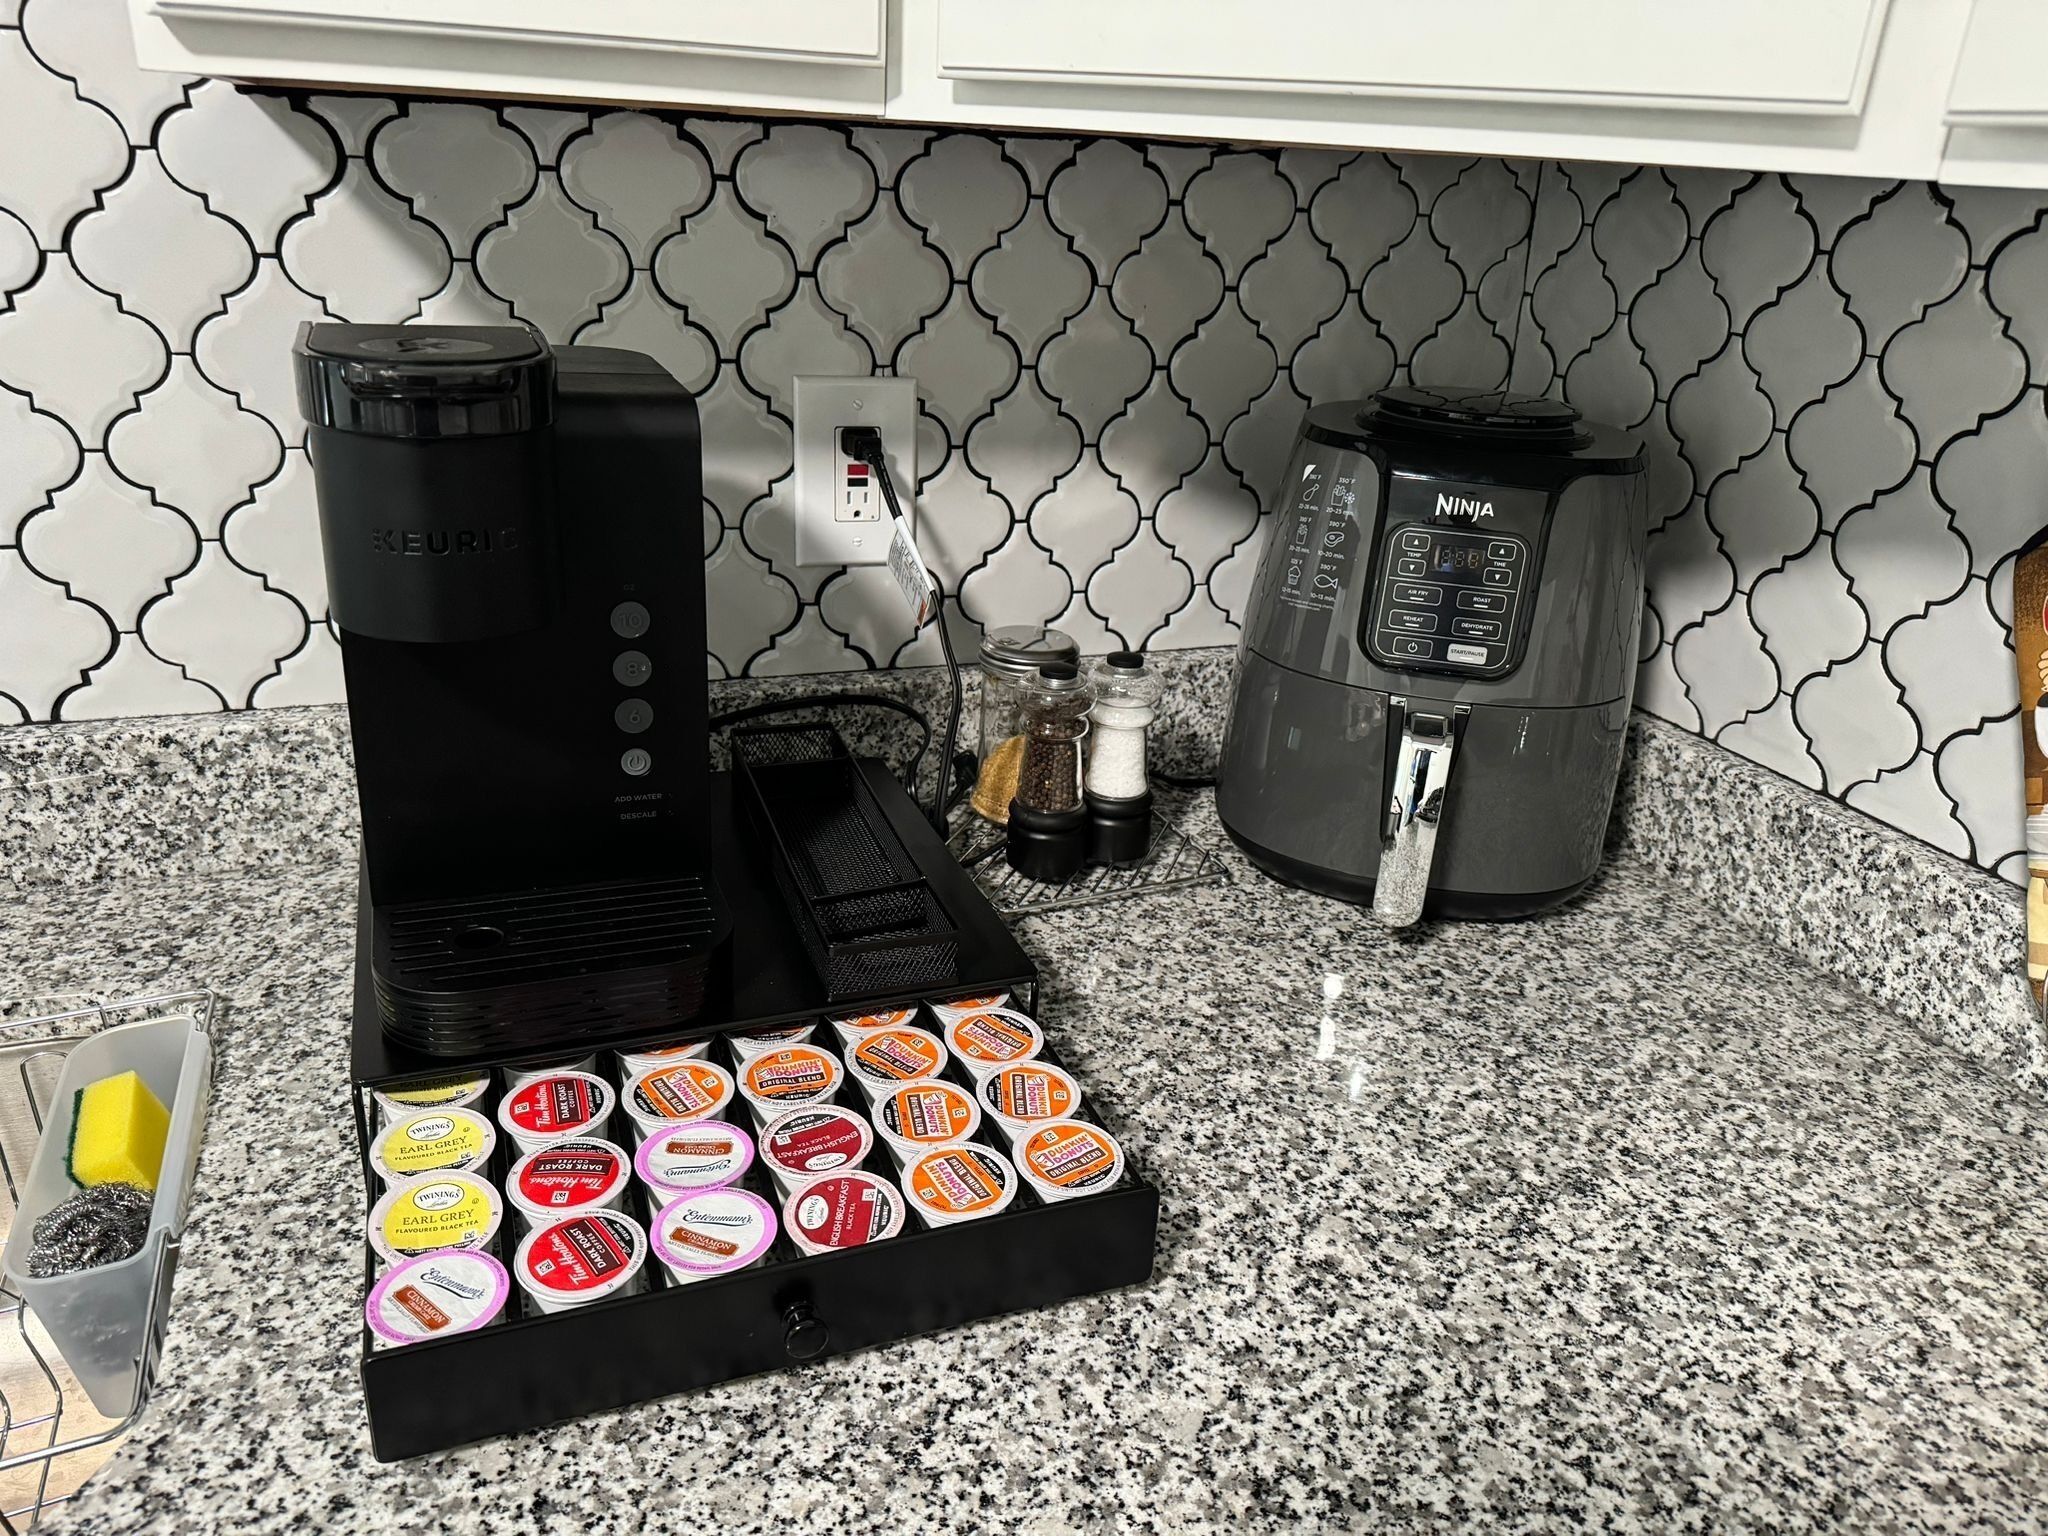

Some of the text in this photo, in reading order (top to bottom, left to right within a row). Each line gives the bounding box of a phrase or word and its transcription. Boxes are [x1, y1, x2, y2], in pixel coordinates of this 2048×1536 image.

[1435, 493, 1494, 522] NINJA
[618, 613, 643, 627] 10
[1461, 622, 1493, 631] DEHYDRATE
[1451, 649, 1485, 657] START/PAUSE
[626, 662, 638, 677] 8
[629, 710, 641, 724] 6
[633, 793, 662, 801] WATER
[620, 810, 657, 820] DESCALE
[960, 1031, 998, 1052] DUNKIN'
[968, 1026, 1003, 1048] DONUTS
[868, 1047, 895, 1064] ORIGINAL
[893, 1059, 913, 1072] BLEND
[887, 1047, 923, 1068] DONUTS
[893, 1041, 932, 1064] DUNKIN'
[774, 1059, 820, 1071] DUNKIN'
[775, 1064, 821, 1076] DONUTS
[683, 1078, 711, 1104] DUNKIN'
[762, 1075, 822, 1087] ORIGINAL BLEND
[558, 1083, 570, 1119] DARK ROAST
[568, 1090, 576, 1108] COFFEE
[674, 1082, 700, 1109] DONUTS
[1027, 1086, 1039, 1115] DONUTS
[1036, 1086, 1048, 1116] DUNKIN'
[410, 1121, 451, 1135] TWININGS
[535, 1109, 552, 1127] Tim
[924, 1105, 939, 1133] DONUTS
[934, 1105, 949, 1135] DUNKIN'
[400, 1135, 467, 1155] EARL GREY
[777, 1131, 858, 1159] ENGLISH BREAKFAST
[811, 1135, 831, 1144] BLACK
[1047, 1134, 1089, 1157] DUNKIN'
[394, 1152, 435, 1161] FLAVOURED
[437, 1147, 459, 1155] BLACK
[1052, 1140, 1095, 1164] DONUTS
[575, 1163, 603, 1171] DARK
[949, 1158, 966, 1175] BLEND
[1049, 1161, 1079, 1177] ORIGINAL
[1081, 1150, 1102, 1164] BLEND
[578, 1177, 604, 1189] Tim
[925, 1164, 958, 1198] DUNKIN'
[936, 1161, 967, 1196] DONUTS
[963, 1174, 987, 1197] ORIGINAL
[417, 1190, 460, 1203] TWININGS
[402, 1208, 474, 1226] EARL GREY
[807, 1197, 820, 1226] TWININGS
[829, 1180, 850, 1246] ENGLISH BREAKFAST
[846, 1213, 855, 1230] BLACK
[395, 1219, 479, 1234] FLAVOURED BLACK TEA
[569, 1227, 607, 1269] DARK ROAST
[586, 1232, 606, 1254] COFFEE
[681, 1230, 732, 1250] CINNAMON
[568, 1262, 590, 1285] Tim
[407, 1290, 446, 1323] CINNAMON
